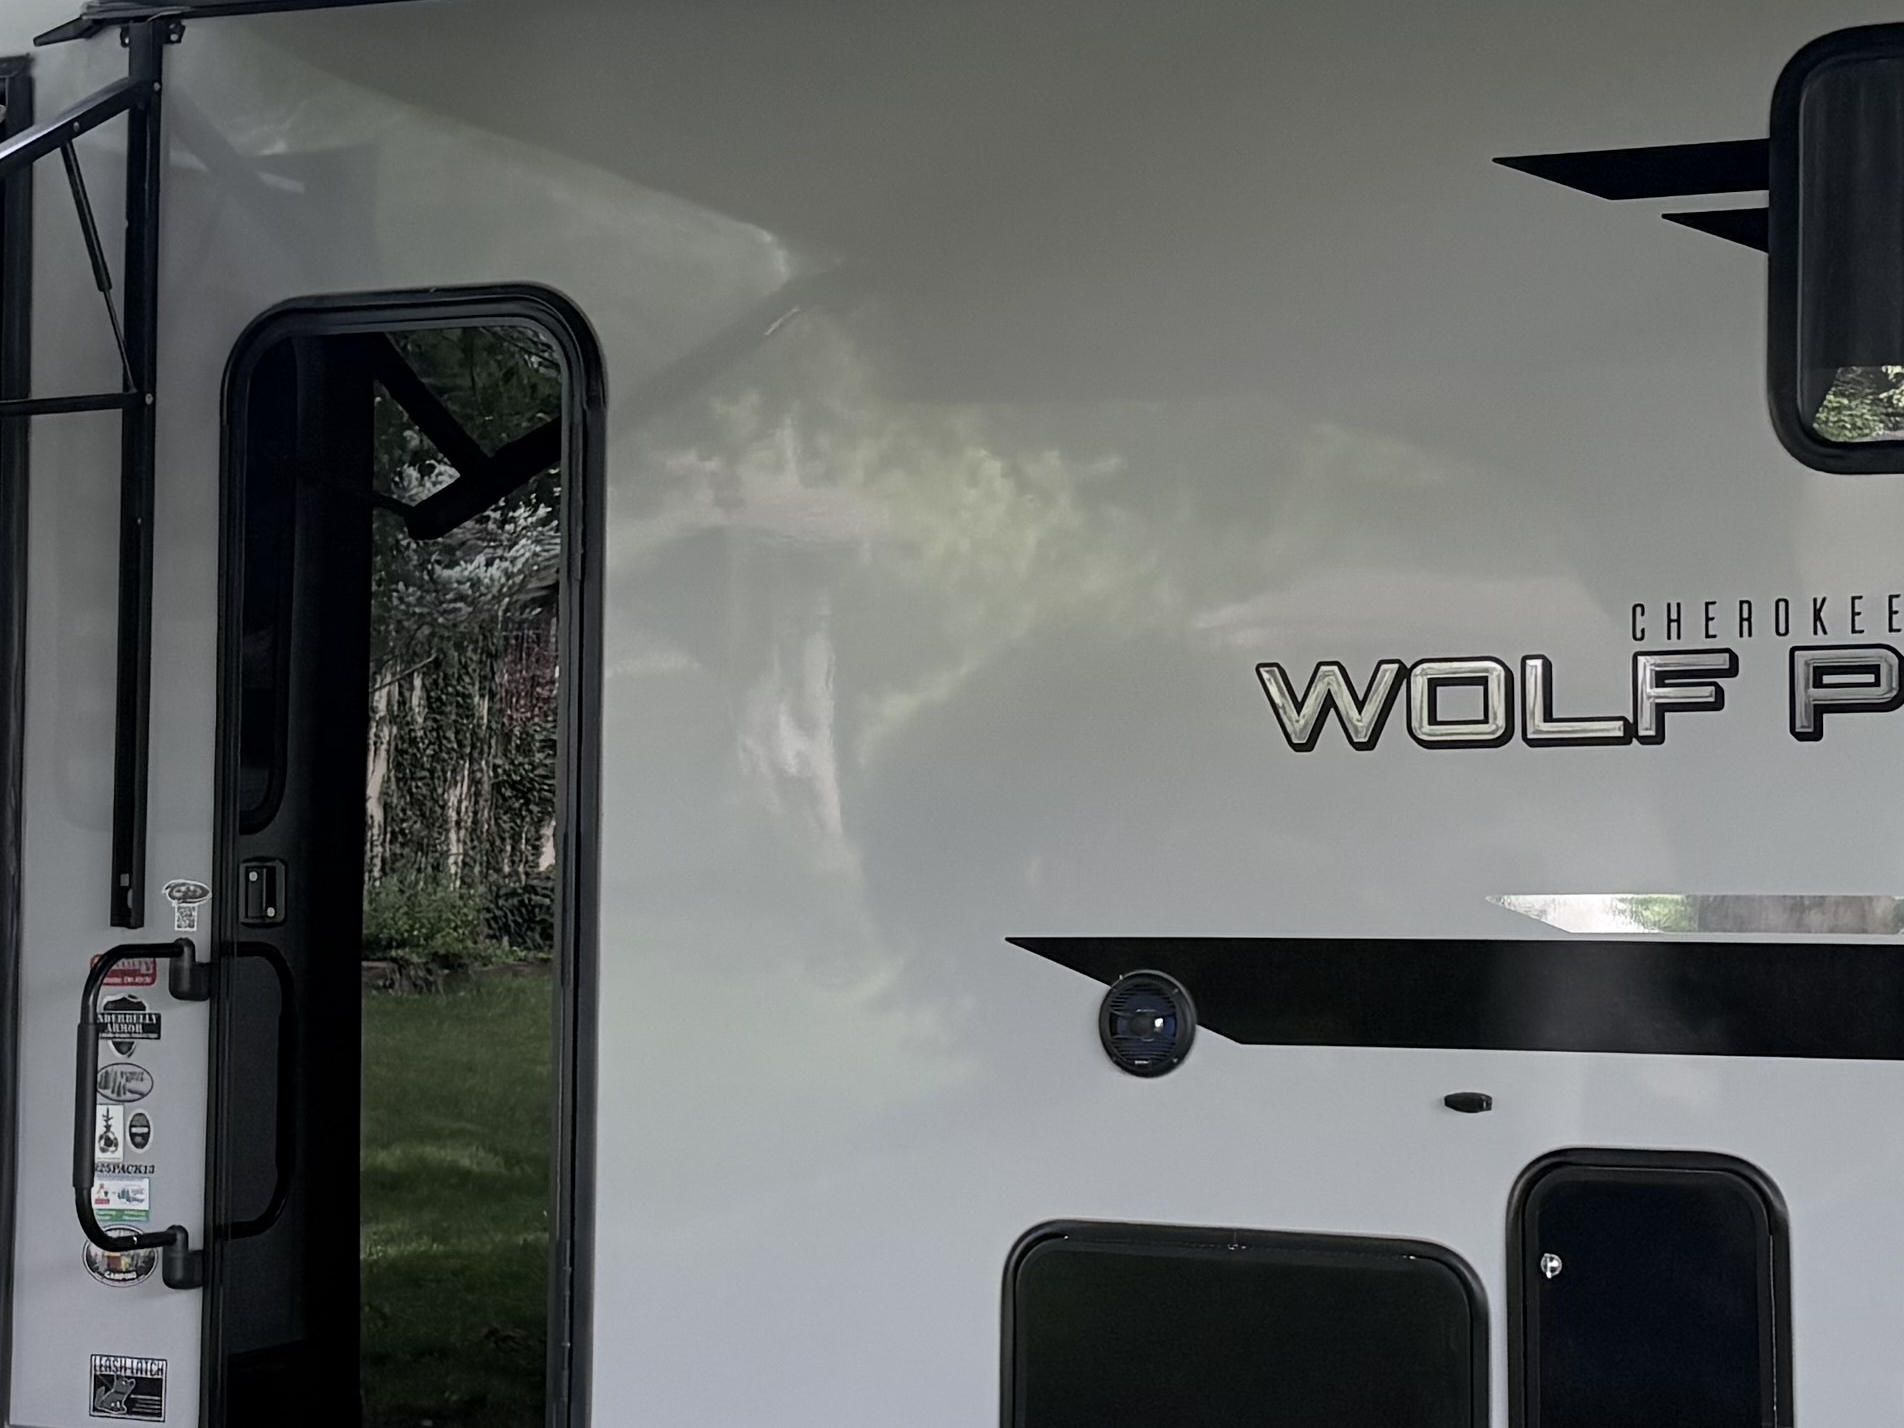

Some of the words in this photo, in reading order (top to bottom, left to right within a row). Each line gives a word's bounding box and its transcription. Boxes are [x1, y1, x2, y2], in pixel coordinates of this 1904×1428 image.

[1630, 592, 1904, 642] CHEROKEE
[1255, 647, 1739, 752] WOLF
[97, 1014, 156, 1024] NDERBELLY
